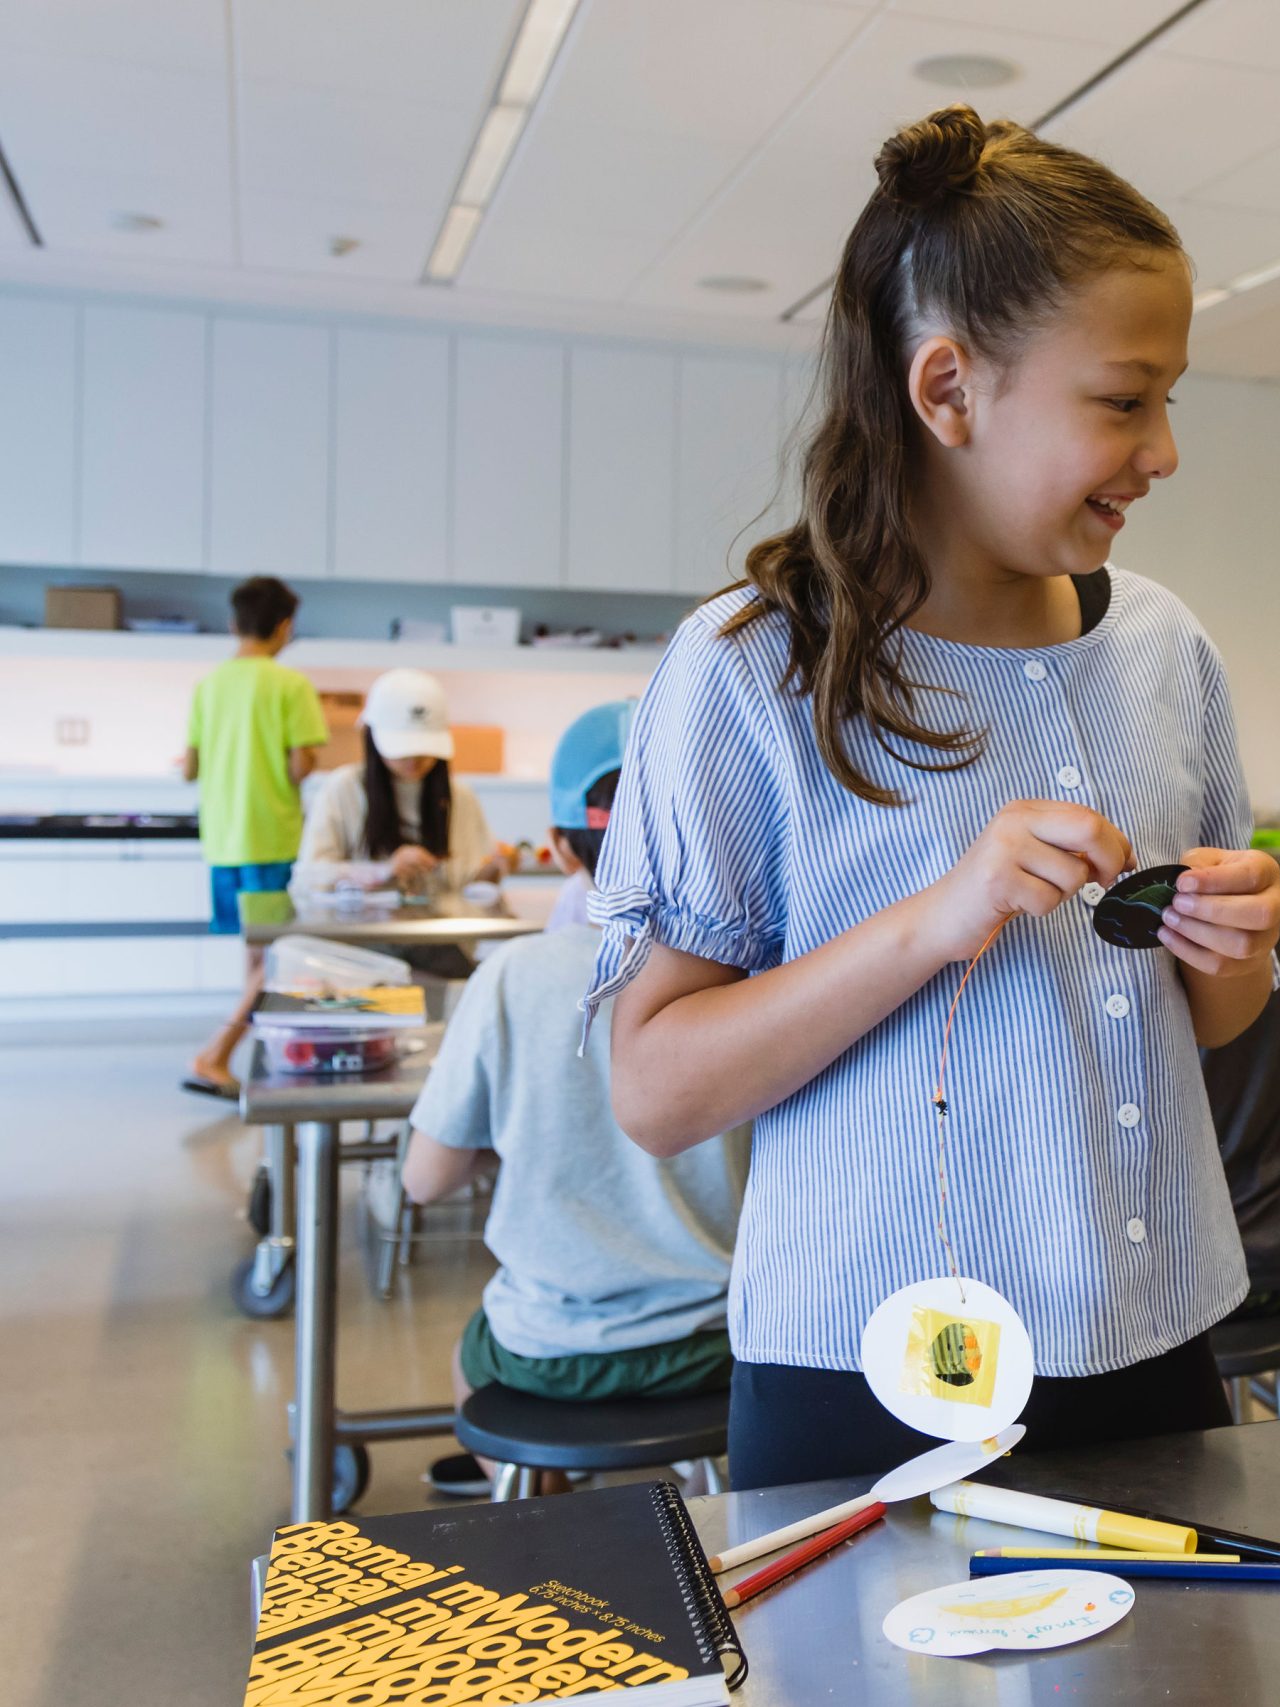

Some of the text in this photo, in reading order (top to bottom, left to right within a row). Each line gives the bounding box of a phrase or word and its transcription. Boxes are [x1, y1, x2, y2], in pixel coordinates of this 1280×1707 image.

[543, 1579, 610, 1609] Sketchbook
[553, 1594, 593, 1615] inches
[624, 1623, 666, 1644] inches
